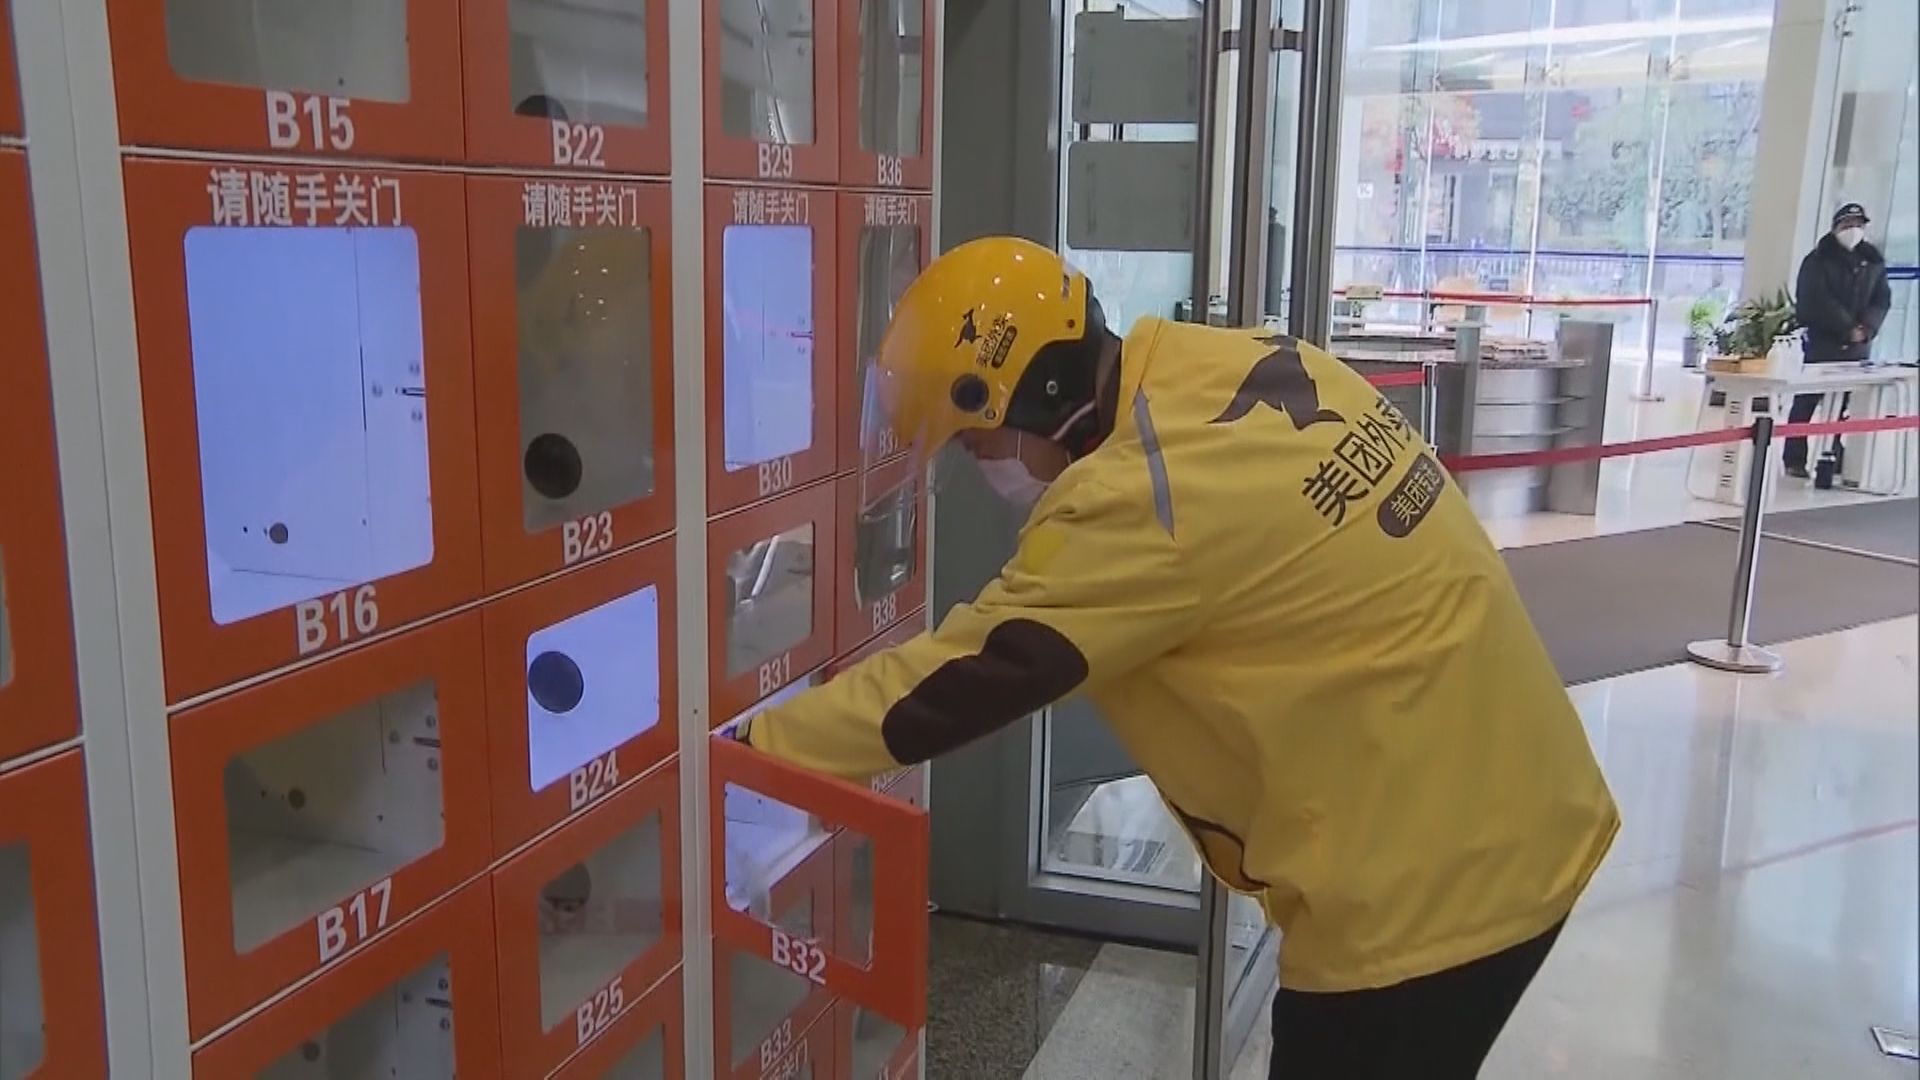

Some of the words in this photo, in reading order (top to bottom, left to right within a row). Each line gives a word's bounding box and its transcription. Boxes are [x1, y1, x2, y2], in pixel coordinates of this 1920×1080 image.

[267, 91, 355, 150] B15
[553, 122, 605, 167] B22
[758, 144, 793, 178] B29
[877, 155, 902, 185] B36
[207, 168, 401, 227] 请随手关门
[522, 184, 639, 227] 请随手关门
[733, 190, 809, 224] 请随手关门
[864, 196, 918, 224] 请随手关门
[758, 458, 792, 497] B30
[563, 511, 614, 566] B23
[297, 585, 378, 654] B16
[873, 593, 897, 632] B38
[759, 652, 790, 697] B31
[571, 751, 620, 810] B24
[317, 877, 392, 963] B17
[771, 929, 827, 985] B32
[577, 977, 623, 1045] B25
[760, 1017, 792, 1072] B33
